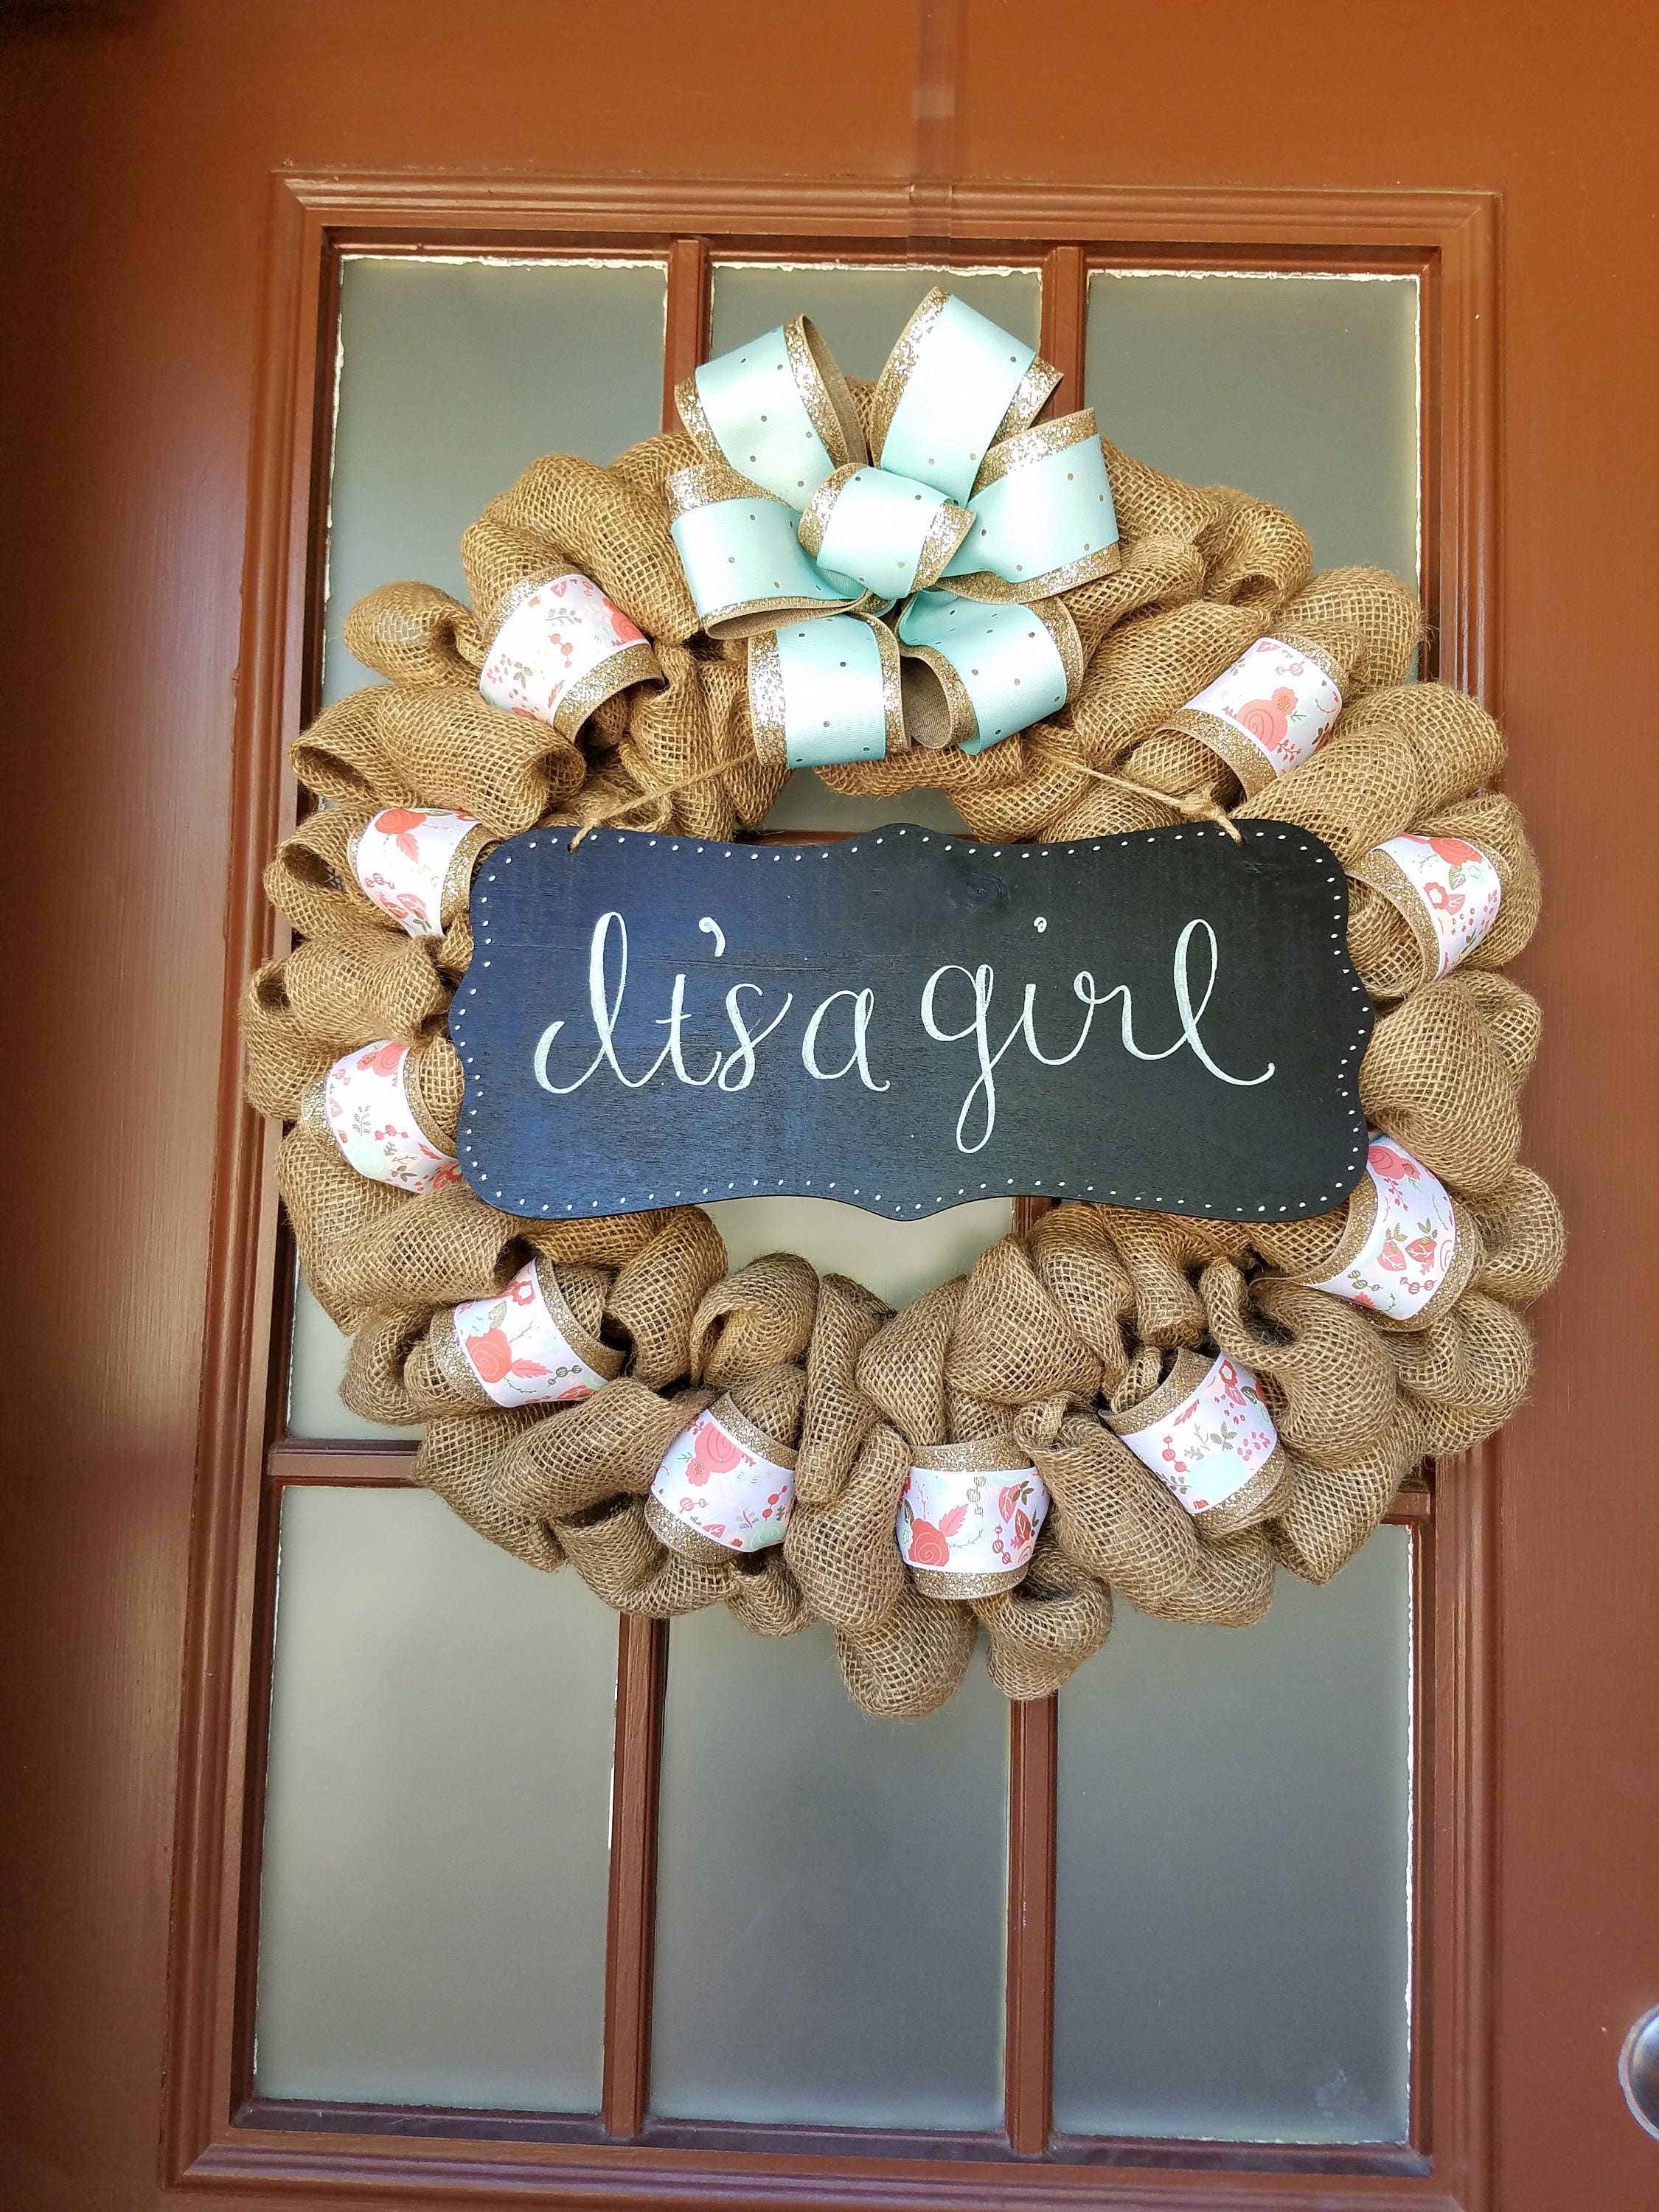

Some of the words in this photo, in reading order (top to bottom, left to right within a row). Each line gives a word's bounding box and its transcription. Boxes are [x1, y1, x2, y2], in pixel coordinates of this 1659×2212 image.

[533, 911, 793, 1094] It's
[801, 987, 891, 1092] a
[920, 917, 1276, 1154] girl
